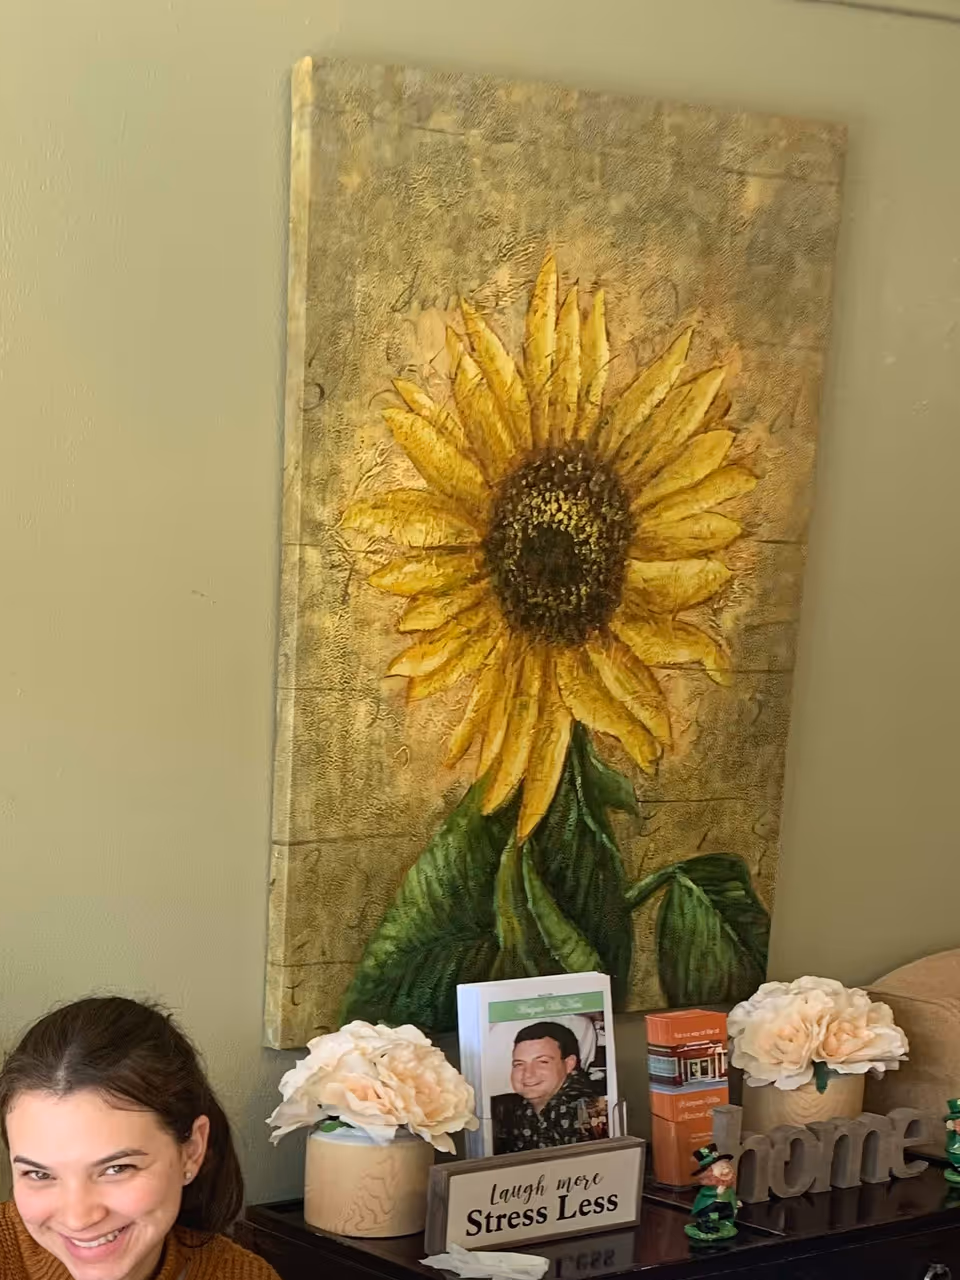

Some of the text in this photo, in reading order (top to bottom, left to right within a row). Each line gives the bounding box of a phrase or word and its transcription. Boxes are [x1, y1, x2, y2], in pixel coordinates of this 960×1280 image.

[712, 1104, 929, 1204] home
[490, 1172, 604, 1206] Laugh more
[465, 1193, 619, 1237] Stress Less
